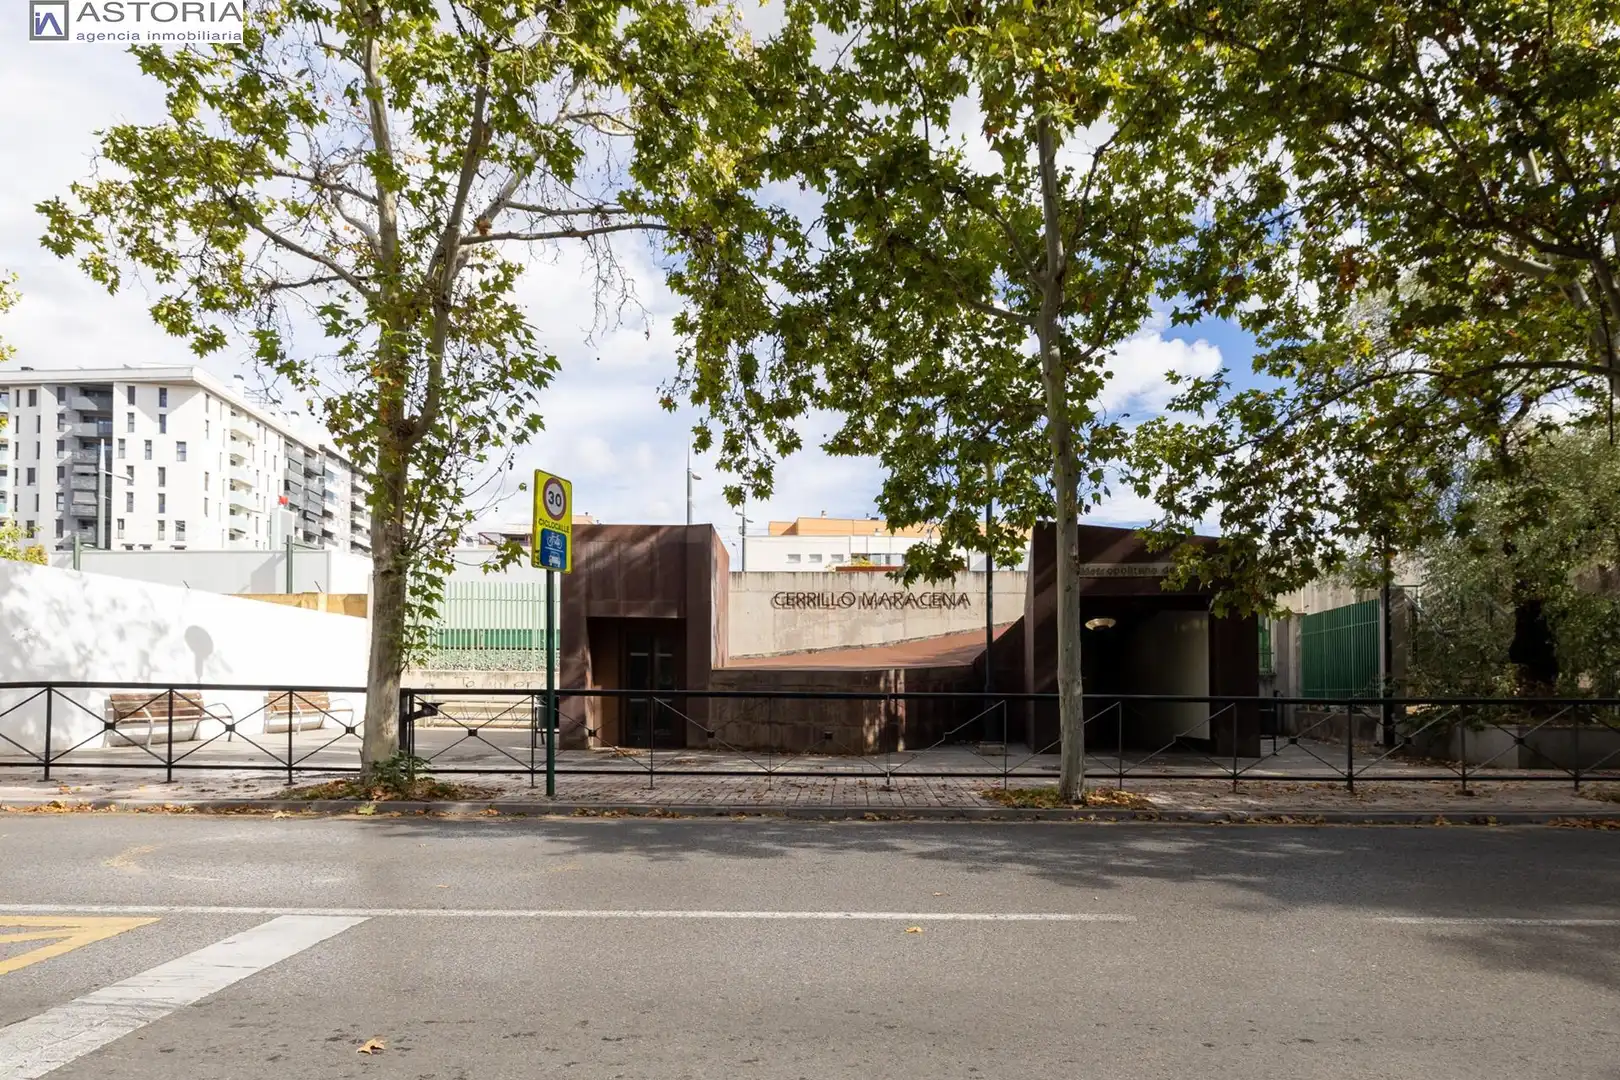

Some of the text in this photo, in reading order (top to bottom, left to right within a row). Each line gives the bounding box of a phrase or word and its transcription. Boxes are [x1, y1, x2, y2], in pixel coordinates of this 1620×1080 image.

[548, 490, 562, 507] 30
[538, 518, 570, 534] CICLOCALLE
[772, 591, 972, 607] CERRILLO MARACENA
